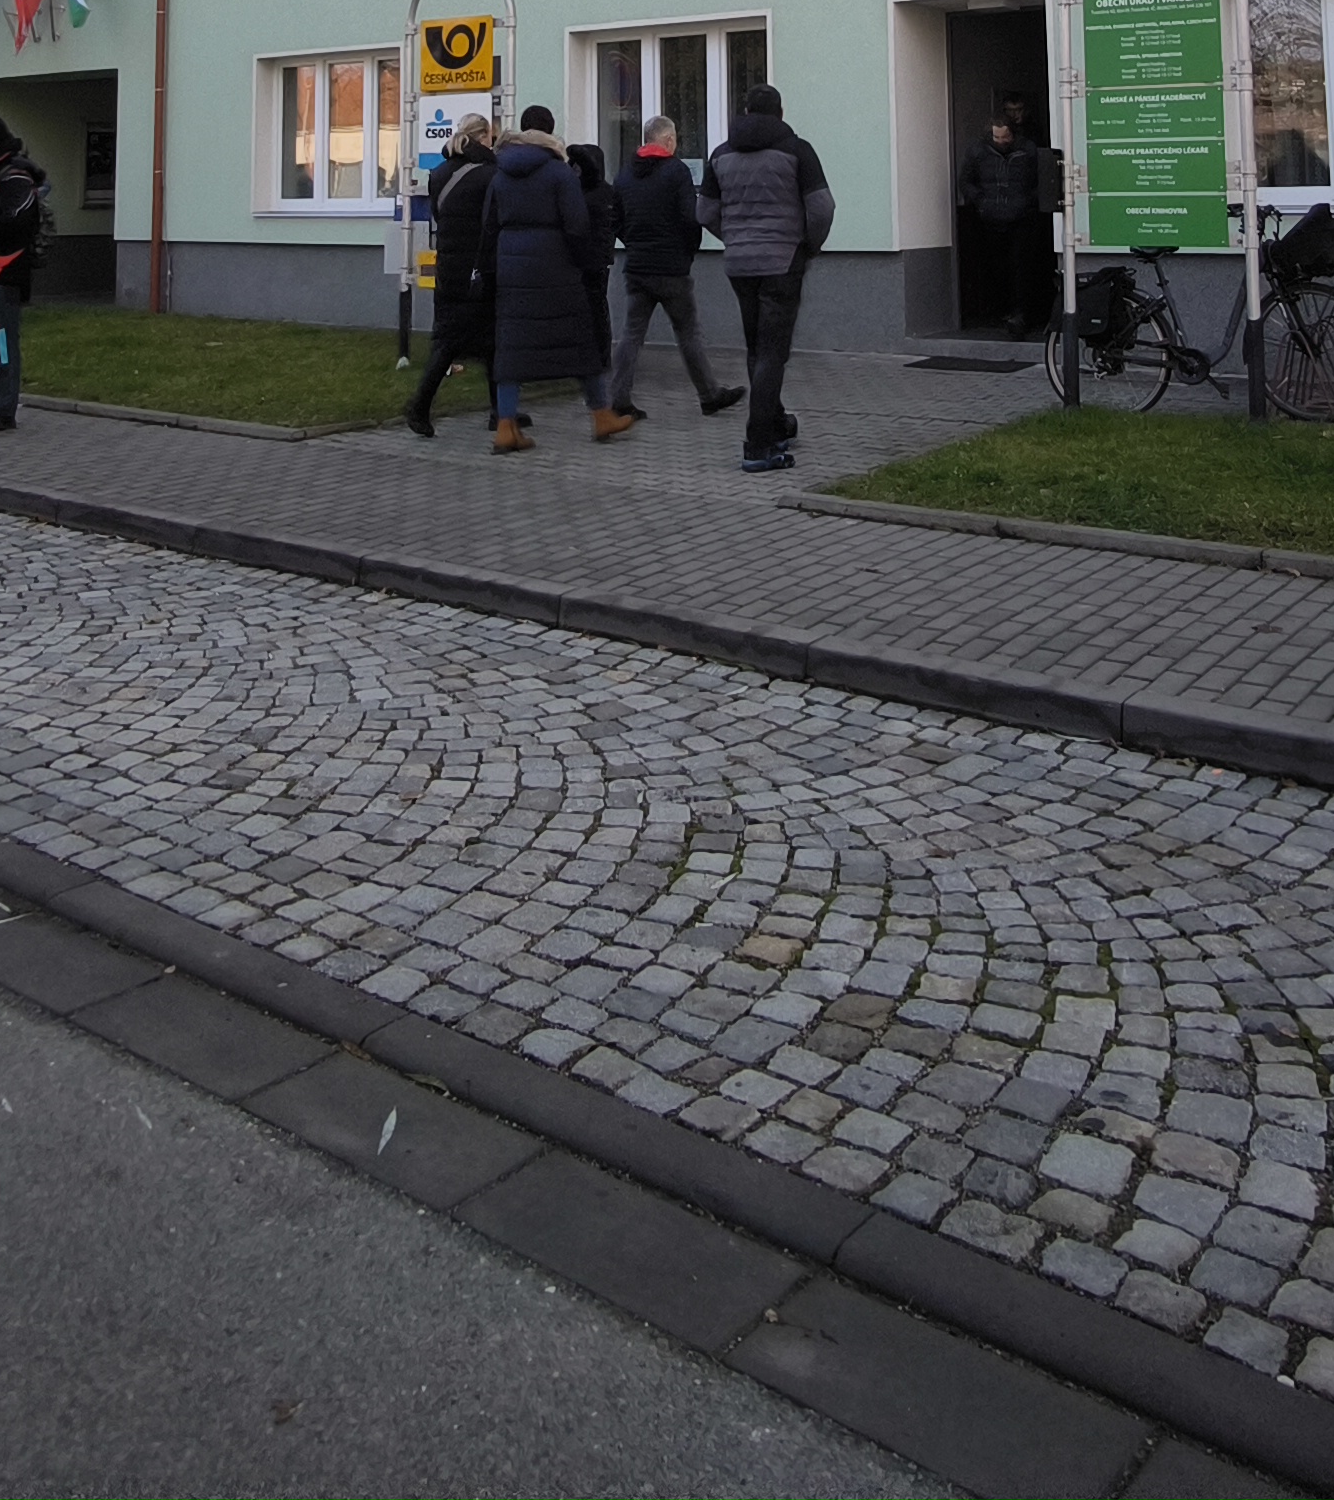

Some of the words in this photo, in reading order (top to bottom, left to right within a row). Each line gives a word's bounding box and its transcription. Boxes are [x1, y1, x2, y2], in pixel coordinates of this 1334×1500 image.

[423, 71, 454, 84] ČESKÁ
[455, 70, 486, 83] POŠTA
[425, 127, 453, 139] ČSOB
